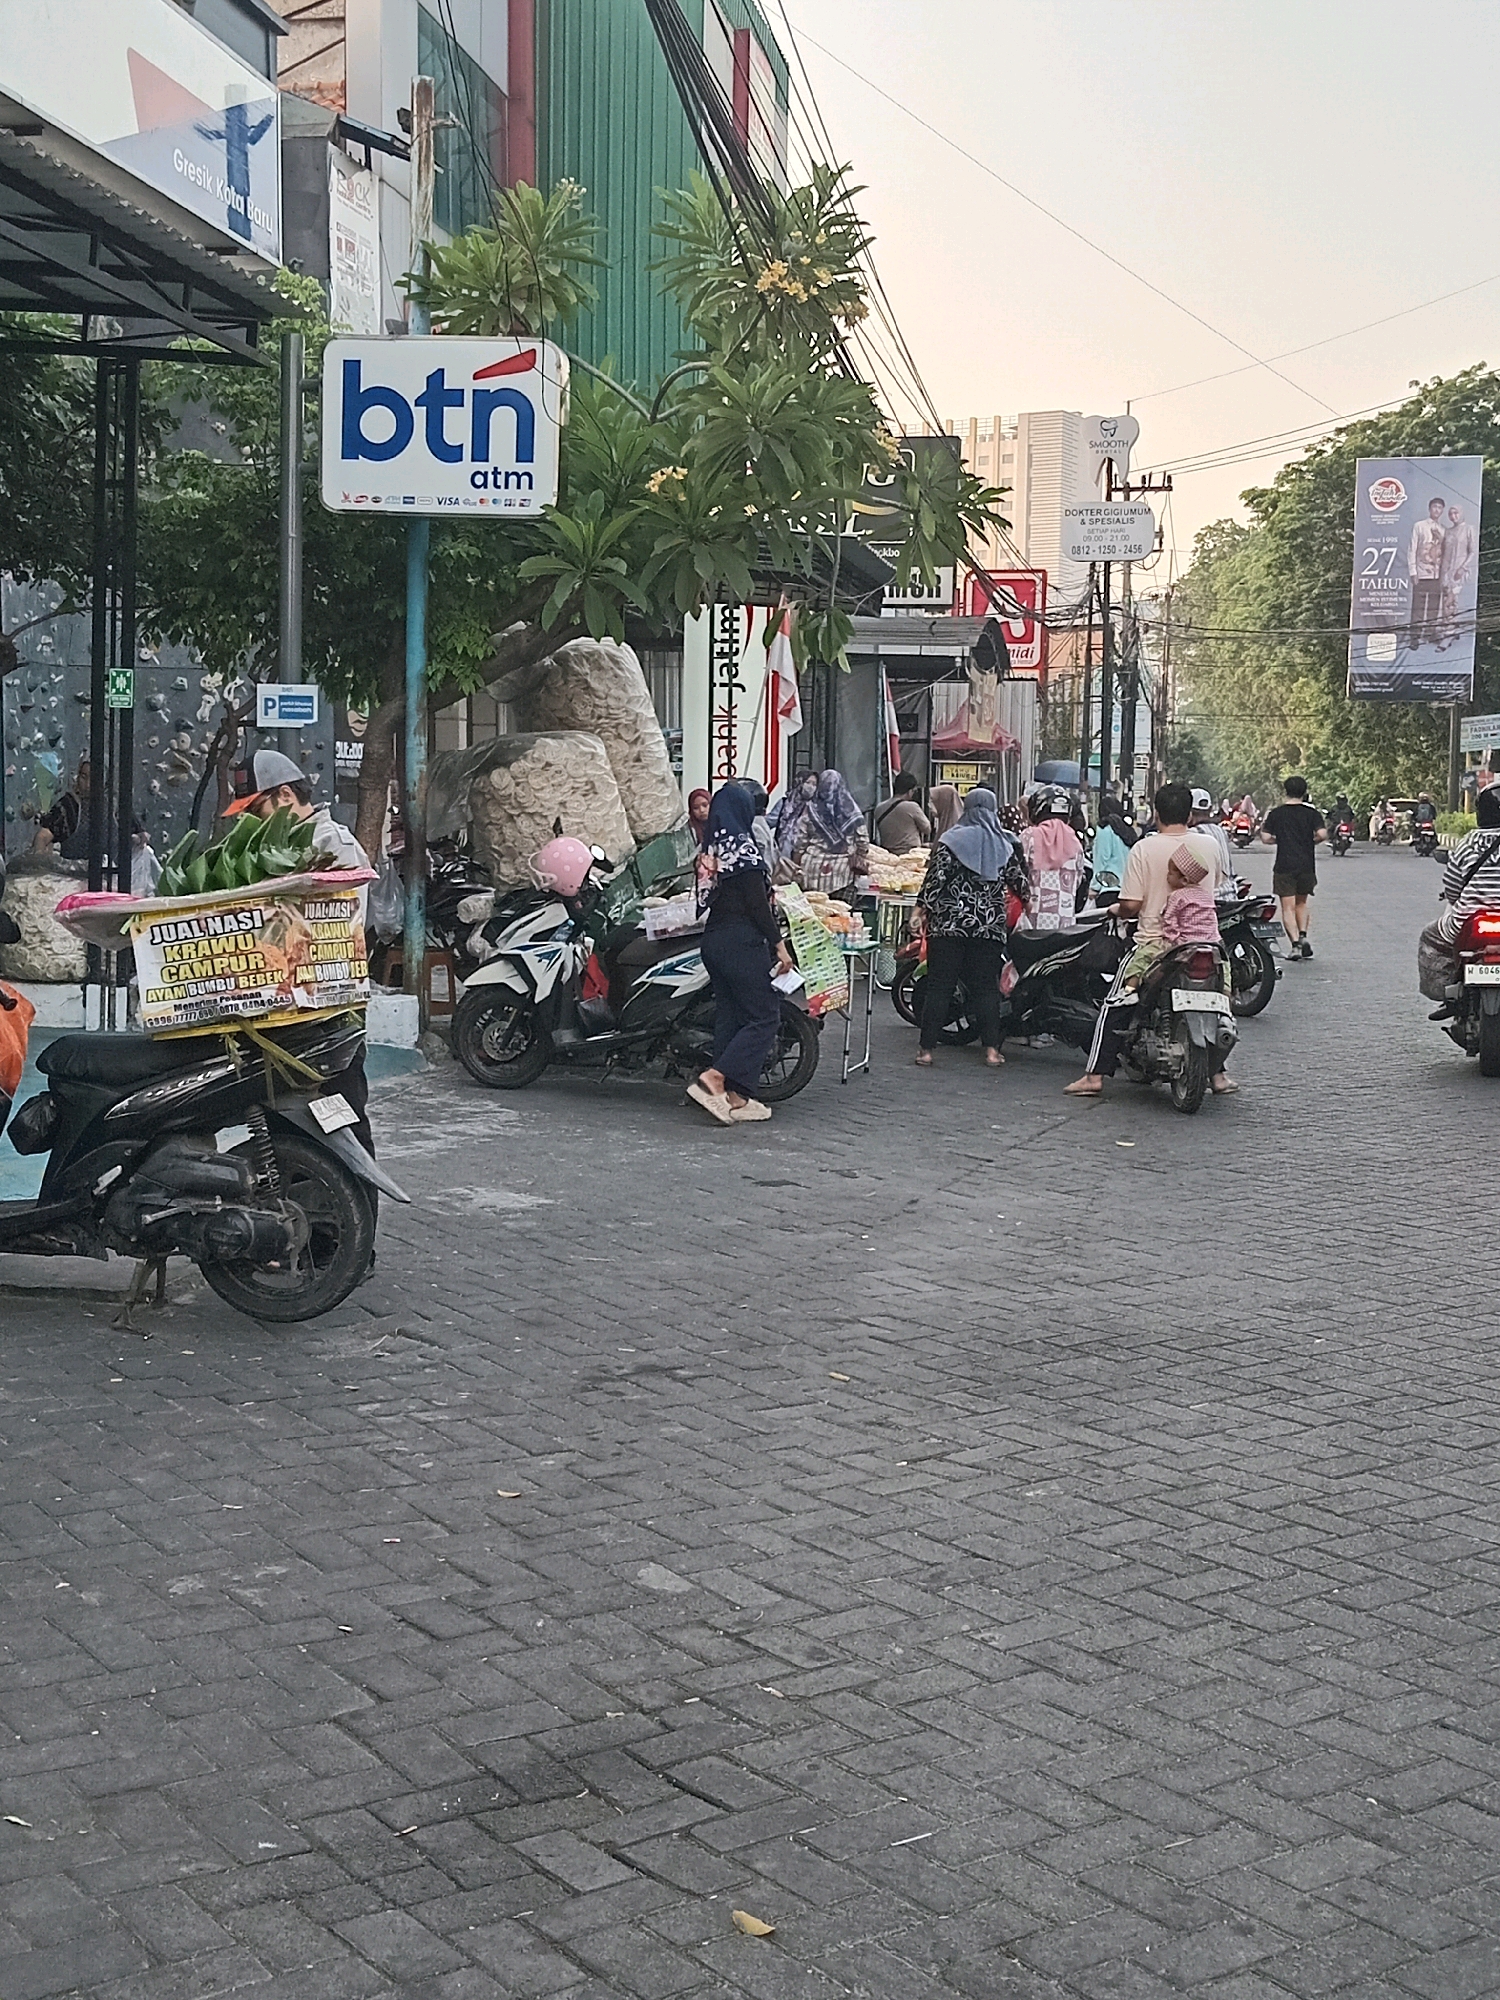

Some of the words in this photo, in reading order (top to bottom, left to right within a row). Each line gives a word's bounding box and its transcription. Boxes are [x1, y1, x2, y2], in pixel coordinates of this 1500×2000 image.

[173, 148, 213, 194] Gresik
[216, 176, 245, 216] Kota
[247, 195, 273, 236] Baru
[341, 359, 535, 464] btn
[1089, 440, 1129, 449] SMOOTH
[470, 466, 534, 491] atm
[436, 497, 461, 506] VISA
[1064, 508, 1102, 517] DOKTER
[1103, 508, 1122, 516] GIGI
[1123, 507, 1151, 516] UMUM
[1080, 518, 1086, 526] &
[1088, 517, 1135, 525] SPESIALIS
[1071, 546, 1091, 556] 0812
[1098, 545, 1117, 555] 1250
[1123, 544, 1143, 554] 2456
[1361, 547, 1398, 576] 27
[1358, 578, 1409, 590] TAHUN
[712, 604, 746, 693] jatim
[264, 697, 277, 717] P
[712, 704, 738, 780] bank
[304, 902, 327, 919] JUAL
[328, 900, 350, 918] NASI
[150, 918, 206, 945] JUAL
[206, 909, 264, 936] NASI
[310, 921, 350, 941] KRAWU
[163, 933, 255, 963] KRAWU
[308, 941, 356, 962] CAMPUR
[161, 952, 265, 984] CAMPUR
[315, 961, 350, 981] BUMBU
[1468, 966, 1474, 975] W
[146, 984, 187, 1003] AYAM
[187, 977, 236, 997] BUMBU
[238, 969, 284, 989] BEBEK
[1174, 991, 1180, 1000] S
[173, 997, 218, 1012] Menerima
